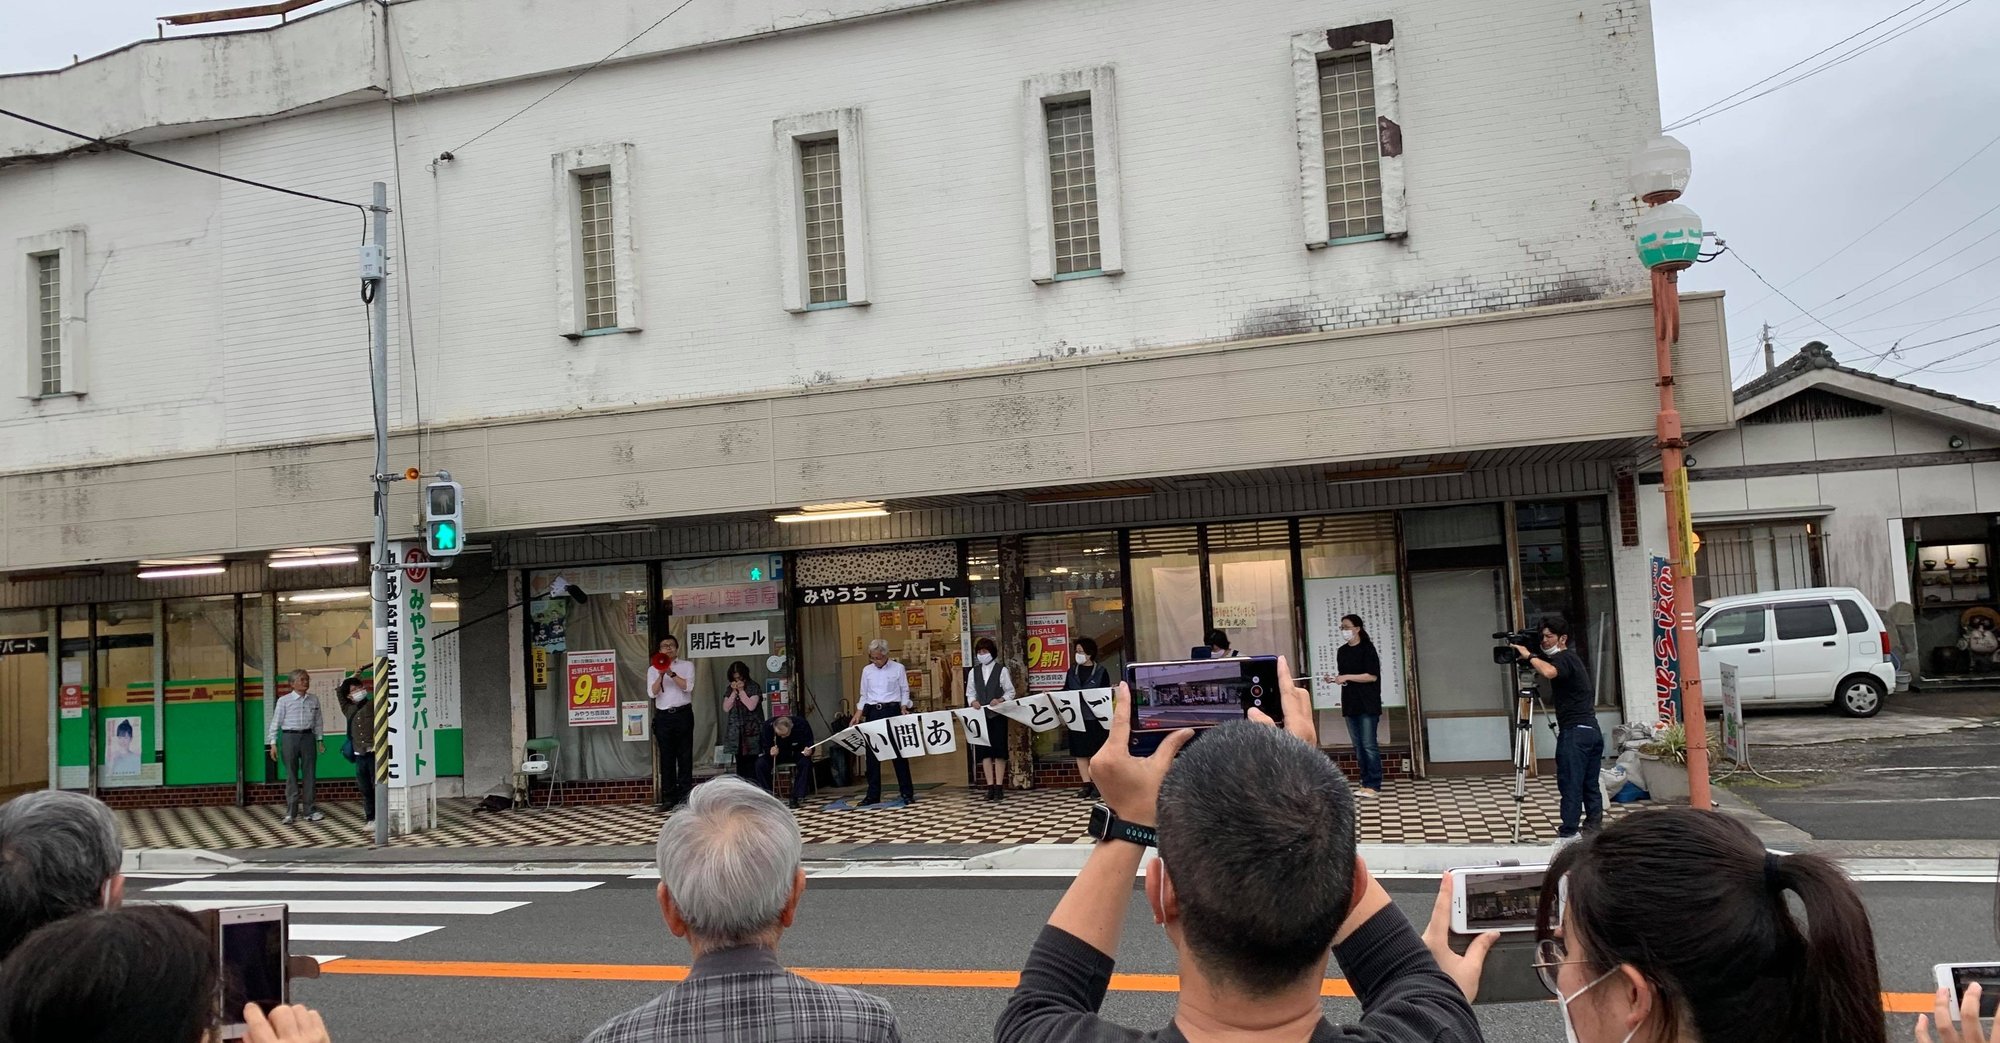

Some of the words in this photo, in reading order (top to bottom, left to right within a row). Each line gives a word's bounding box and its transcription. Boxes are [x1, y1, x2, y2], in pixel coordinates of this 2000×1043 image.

[770, 557, 783, 578] P
[0, 639, 36, 654] パート
[690, 629, 766, 651] 閉店セール
[409, 588, 429, 776] みやうちデパート
[573, 673, 612, 705] 9割引
[574, 709, 611, 717] みやうち百貨店
